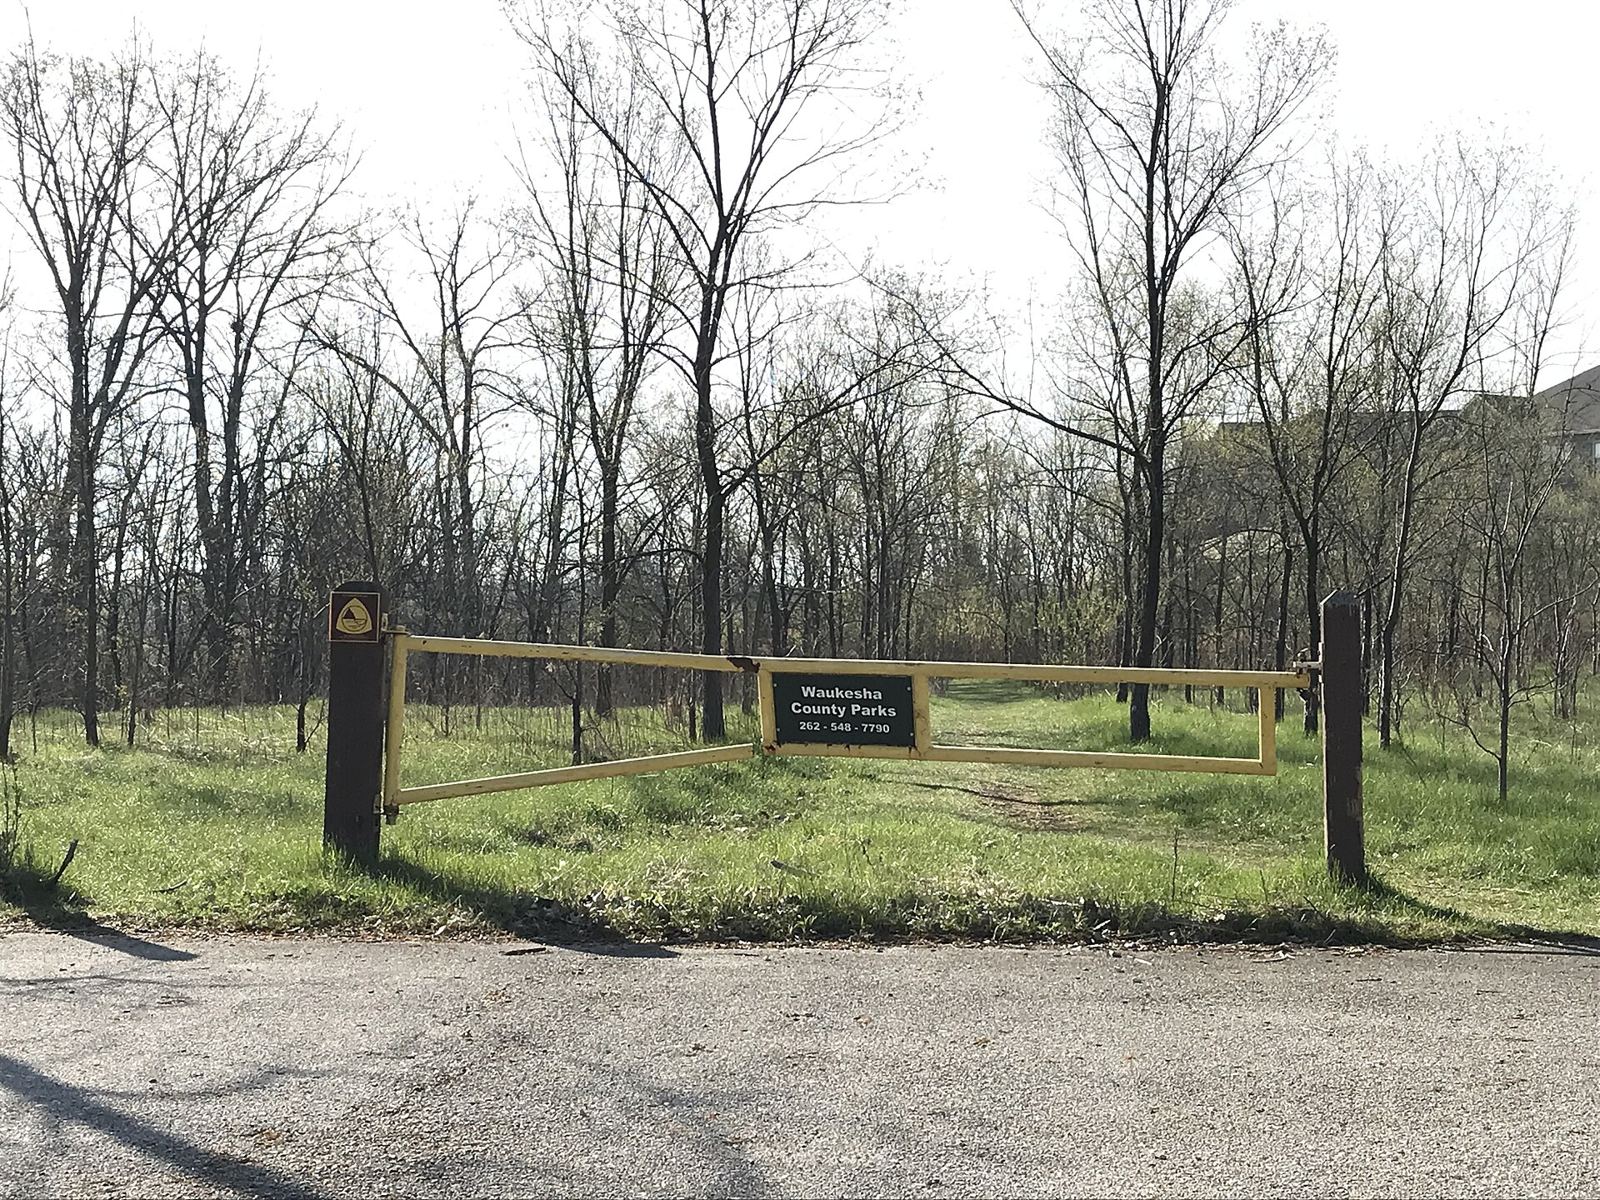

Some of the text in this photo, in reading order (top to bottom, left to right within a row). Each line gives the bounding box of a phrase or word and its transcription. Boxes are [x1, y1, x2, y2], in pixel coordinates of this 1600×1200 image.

[801, 686, 883, 700] Waukesha
[791, 702, 897, 717] County Parks
[799, 721, 820, 731] 262
[831, 722, 852, 732] 548
[861, 723, 890, 733] 7790
